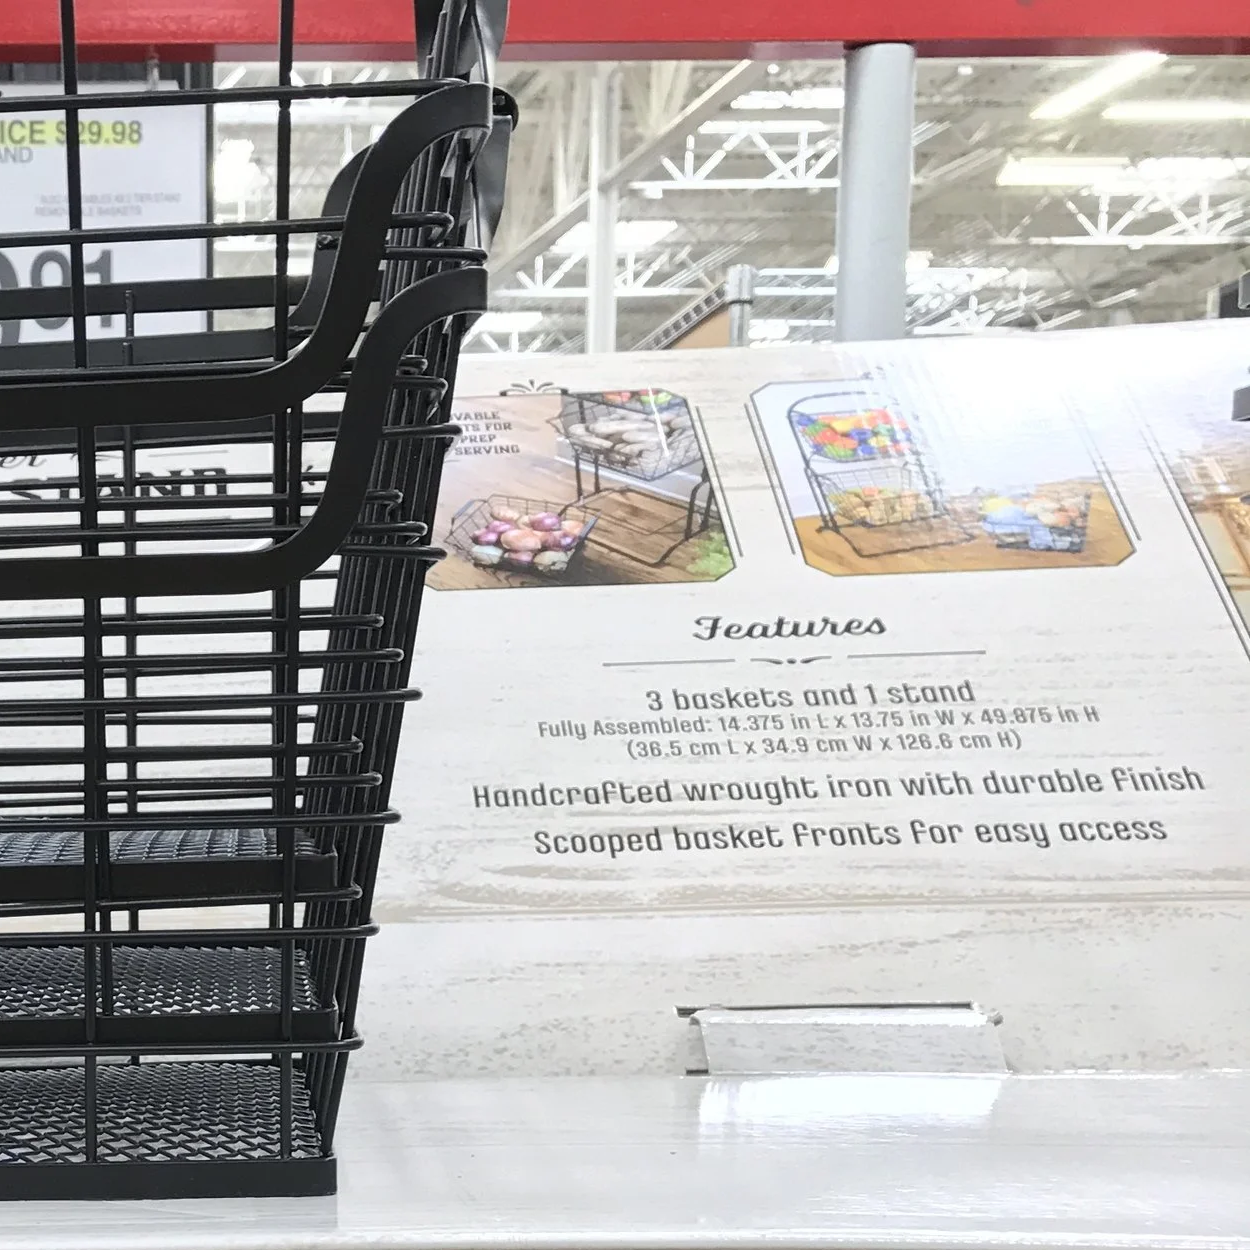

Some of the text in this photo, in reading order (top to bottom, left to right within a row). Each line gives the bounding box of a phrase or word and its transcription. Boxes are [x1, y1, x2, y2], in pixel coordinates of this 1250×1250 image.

[460, 434, 496, 443] PREP
[485, 422, 512, 430] FOR
[454, 445, 520, 455] SERVING
[692, 615, 887, 641] Features
[645, 679, 977, 712] 3 baskets and 1 stand
[537, 705, 1101, 741] Fully Assembled: 14.375 in L x 13.75 in W x 49.875 in H
[626, 727, 1022, 761] (36.5 cm L x 34.9 cm W x 126.6 cm H)
[472, 765, 1206, 808] Handcrafted wrought iron with durable finish
[533, 818, 1168, 859] Scooped basket fronts for easy access
